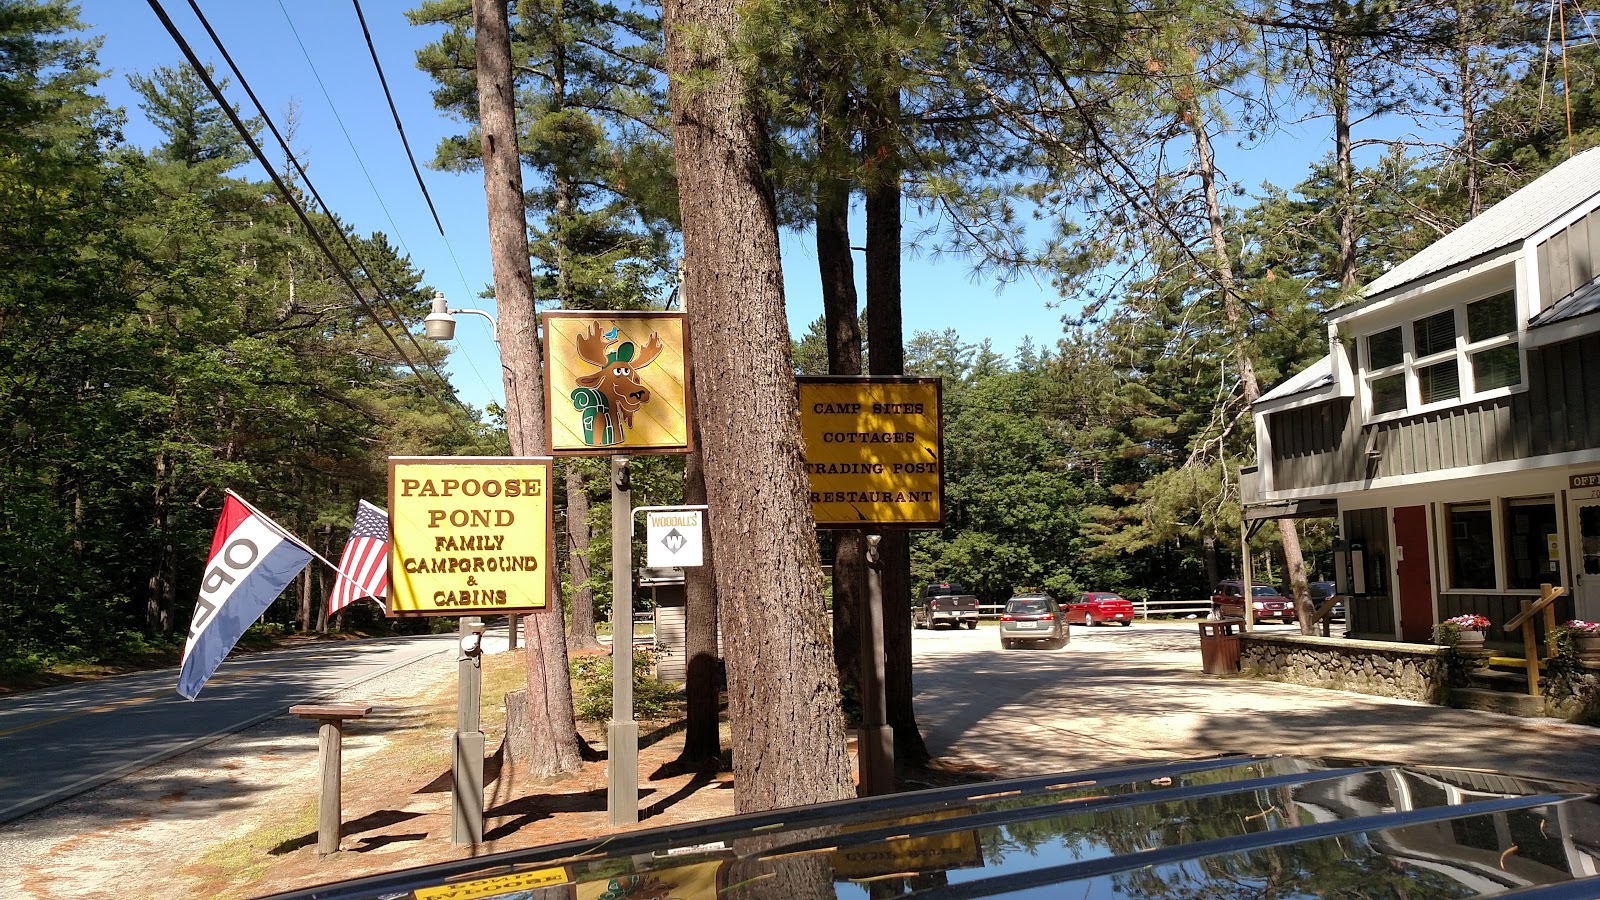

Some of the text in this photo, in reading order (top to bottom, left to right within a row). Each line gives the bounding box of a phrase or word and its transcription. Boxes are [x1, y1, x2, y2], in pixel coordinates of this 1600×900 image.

[813, 403, 924, 415] CAMP SITES
[823, 432, 915, 444] COTTAGES
[806, 462, 937, 475] TRADING POST
[401, 478, 541, 498] PAPOOSE
[811, 491, 932, 503] RESTAURANT
[428, 509, 515, 528] POND
[435, 535, 505, 552] FAMILY
[403, 556, 538, 574] CAMPGROUND
[466, 575, 478, 587] &
[433, 590, 507, 607] CABINS
